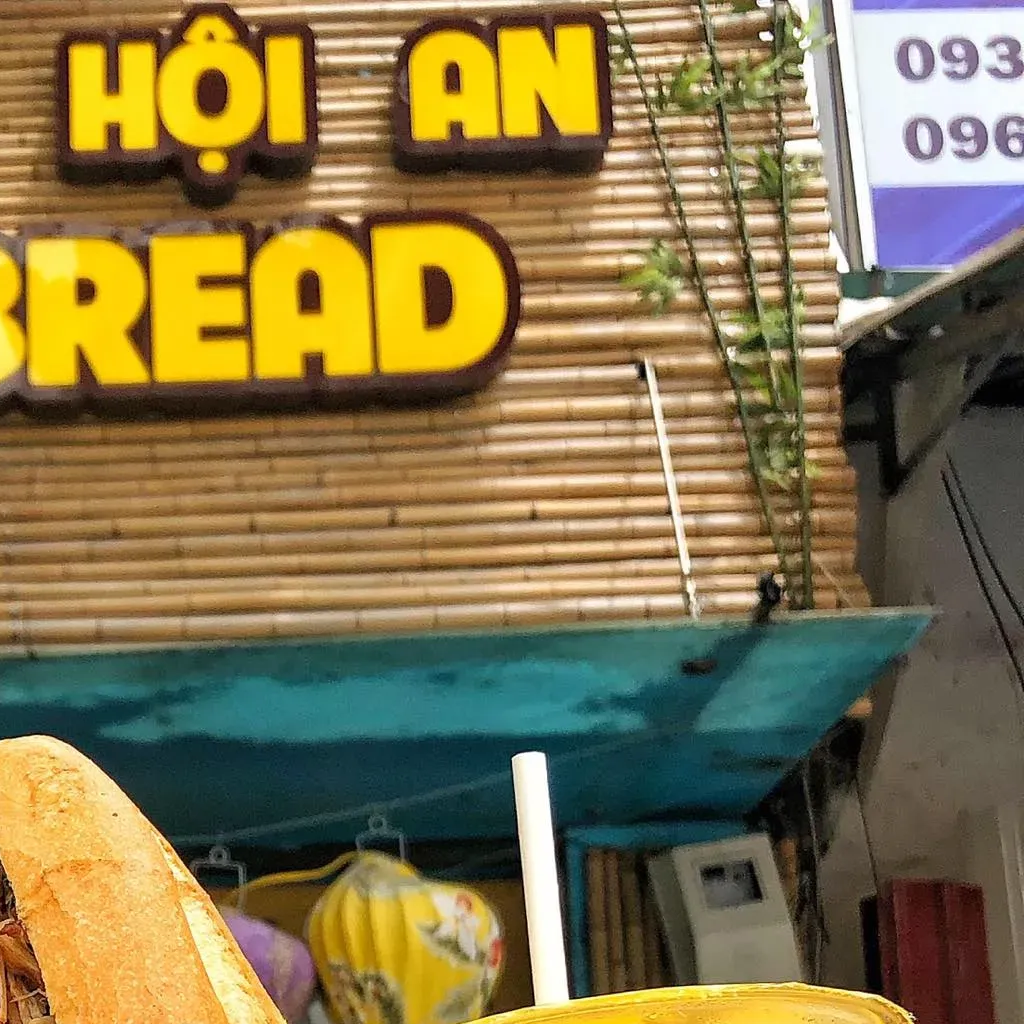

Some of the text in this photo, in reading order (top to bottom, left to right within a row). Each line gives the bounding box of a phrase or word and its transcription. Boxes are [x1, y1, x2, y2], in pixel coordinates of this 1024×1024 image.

[894, 37, 1024, 81] 093
[66, 12, 310, 175] HỘI
[407, 23, 603, 142] AN
[902, 115, 1024, 162] 096
